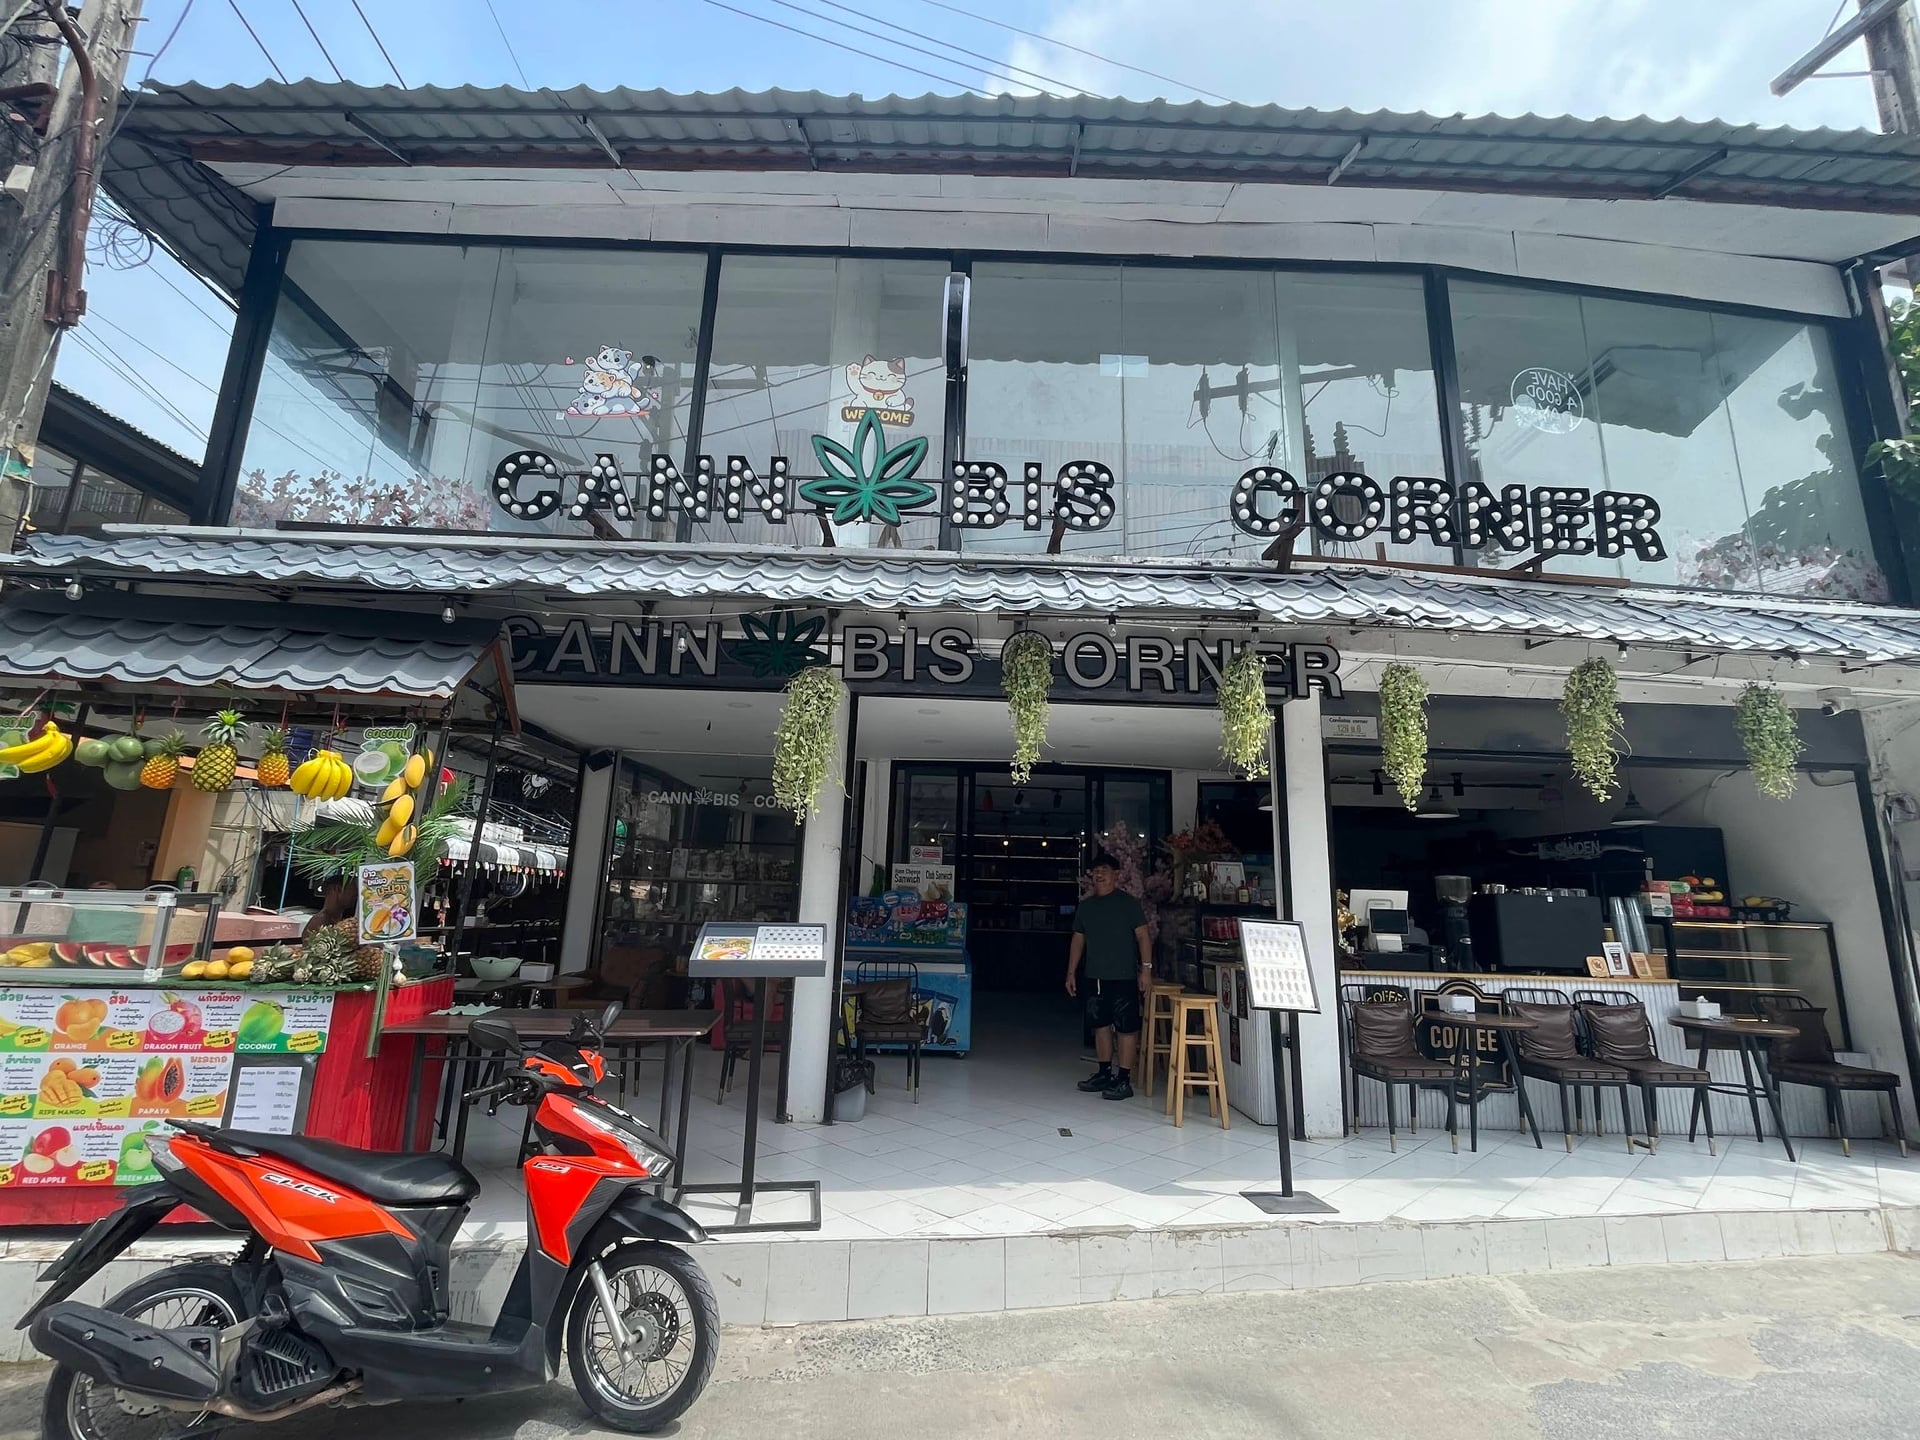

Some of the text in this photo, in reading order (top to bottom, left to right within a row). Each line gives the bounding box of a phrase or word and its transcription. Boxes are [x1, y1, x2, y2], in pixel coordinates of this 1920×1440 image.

[845, 409, 911, 424] WEOME
[1230, 466, 1669, 562] CORNER
[365, 724, 414, 739] coconut
[40, 1176, 66, 1184] APPLE
[117, 1174, 143, 1182] GREEN
[261, 1173, 339, 1204] CLICK
